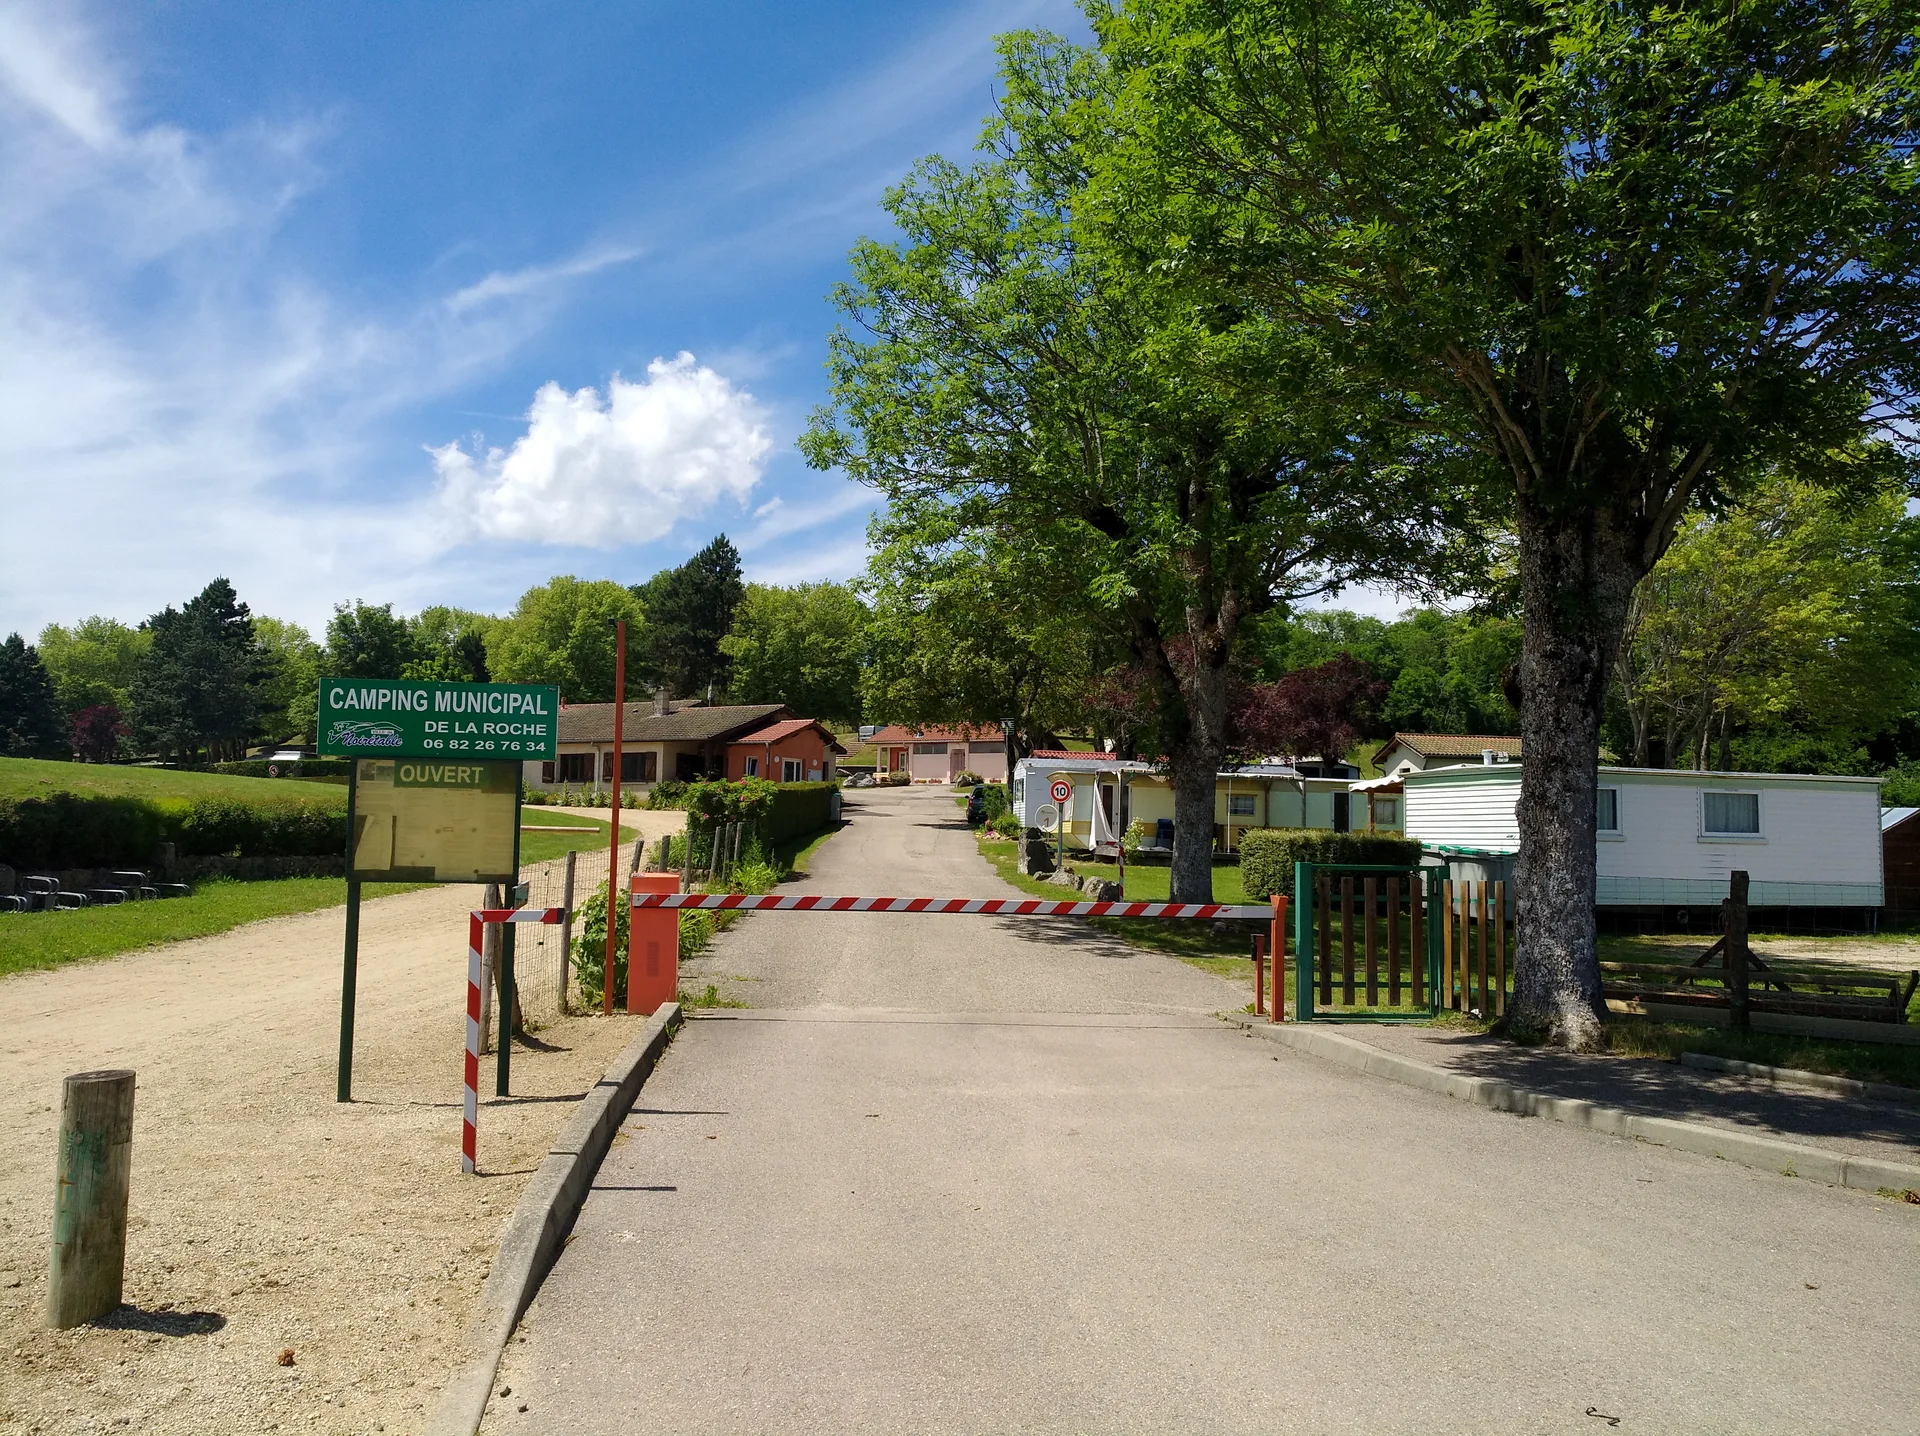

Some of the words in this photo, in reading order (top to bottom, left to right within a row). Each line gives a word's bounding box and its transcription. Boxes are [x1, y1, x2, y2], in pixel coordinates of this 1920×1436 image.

[329, 687, 428, 712] CAMPING
[434, 690, 548, 715] MUNICIPAL
[424, 721, 449, 733] DE
[455, 722, 478, 734] LA
[483, 722, 547, 735] ROCHE
[423, 739, 444, 749] 06
[449, 739, 469, 750] 82
[474, 740, 495, 750] 26
[500, 741, 521, 751] 76
[525, 741, 546, 752] 34
[400, 764, 484, 784] OUVERT
[1055, 787, 1066, 796] 10
